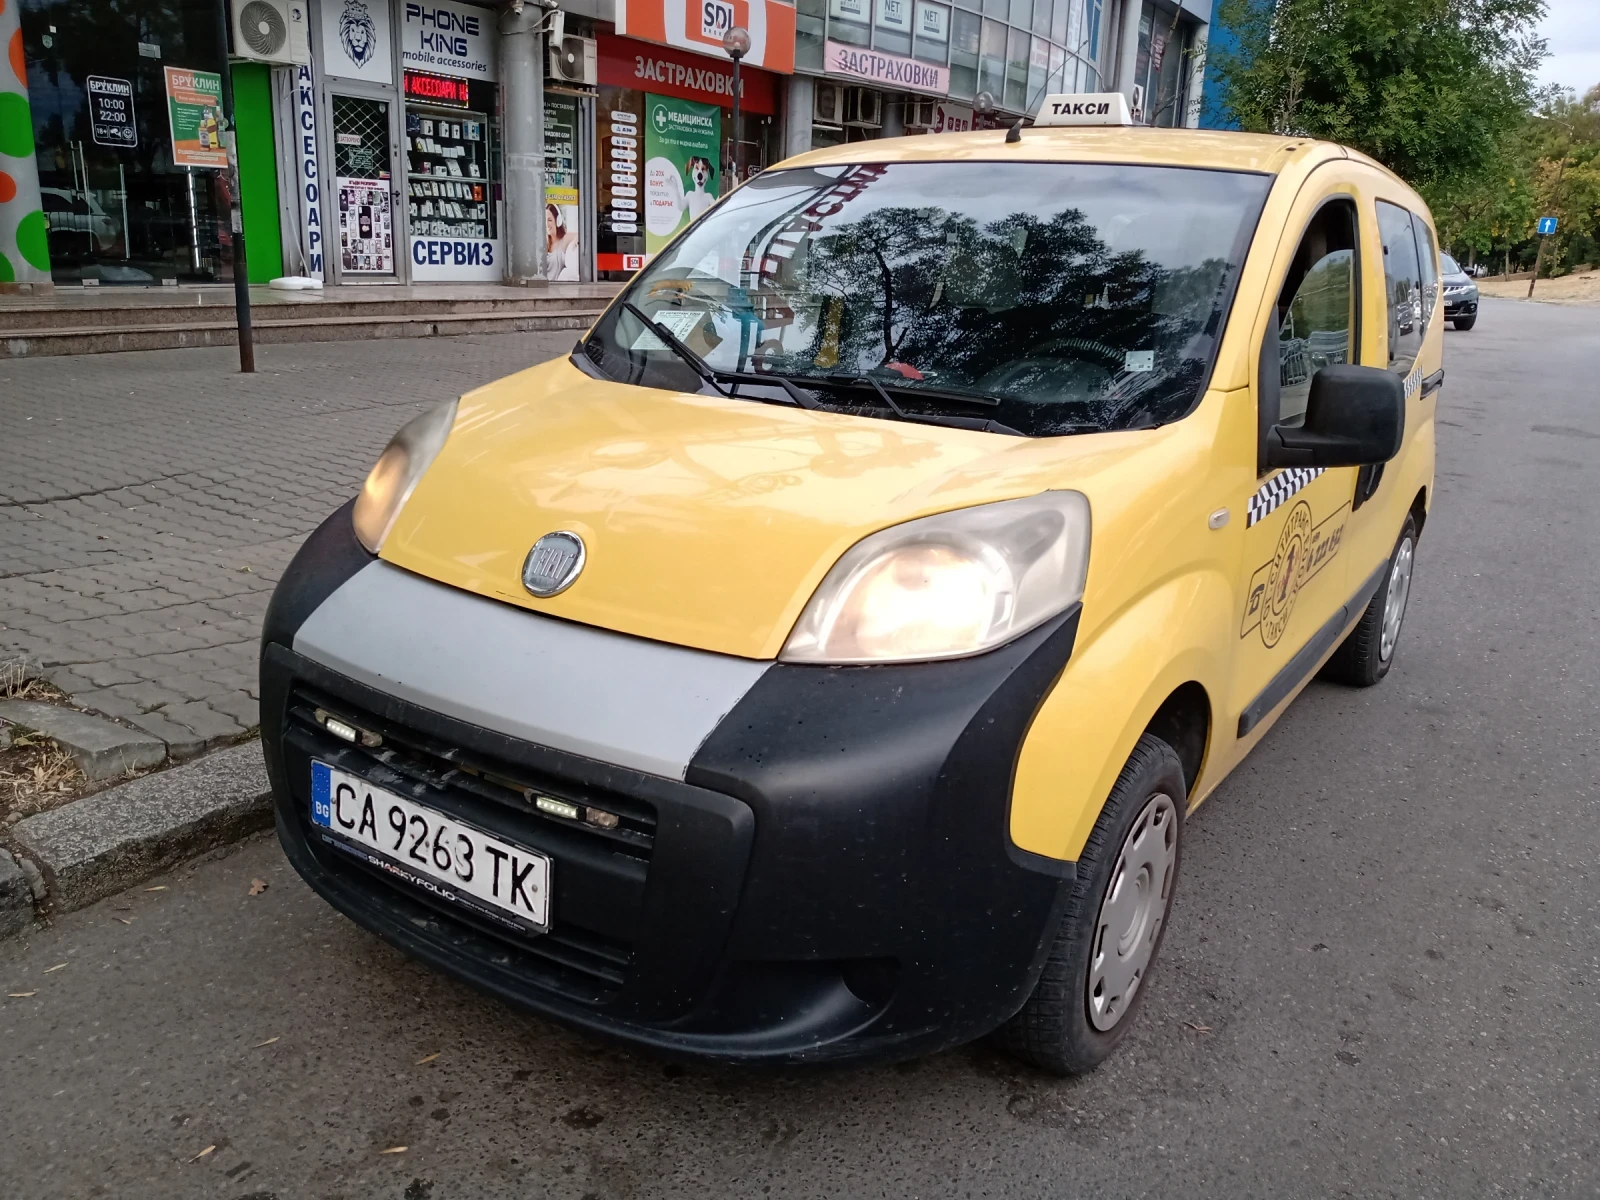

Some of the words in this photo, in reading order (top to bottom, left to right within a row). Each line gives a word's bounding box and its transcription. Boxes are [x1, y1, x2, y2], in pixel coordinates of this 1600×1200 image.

[406, 3, 480, 37] PHONE
[704, 2, 732, 30] SDI
[924, 9, 938, 23] NET
[420, 30, 468, 58] KING
[403, 50, 435, 64] mobile
[437, 57, 487, 73] accessories
[839, 49, 939, 89] ЗАСТРАХОВКИ
[90, 80, 130, 95] БРУКЛИН
[171, 73, 220, 92] БРУКЛИН
[98, 97, 125, 110] 10:00
[1052, 103, 1110, 115] ТАКСИ
[100, 110, 127, 123] 22:00
[668, 111, 713, 127] МЕДИЦИНСКА
[298, 65, 323, 273] АКСЕСОАРИ
[413, 240, 494, 266] СЕРВИЗ
[315, 801, 329, 819] BG
[336, 783, 378, 841] CA
[388, 806, 474, 883] 9263
[485, 844, 536, 913] TK
